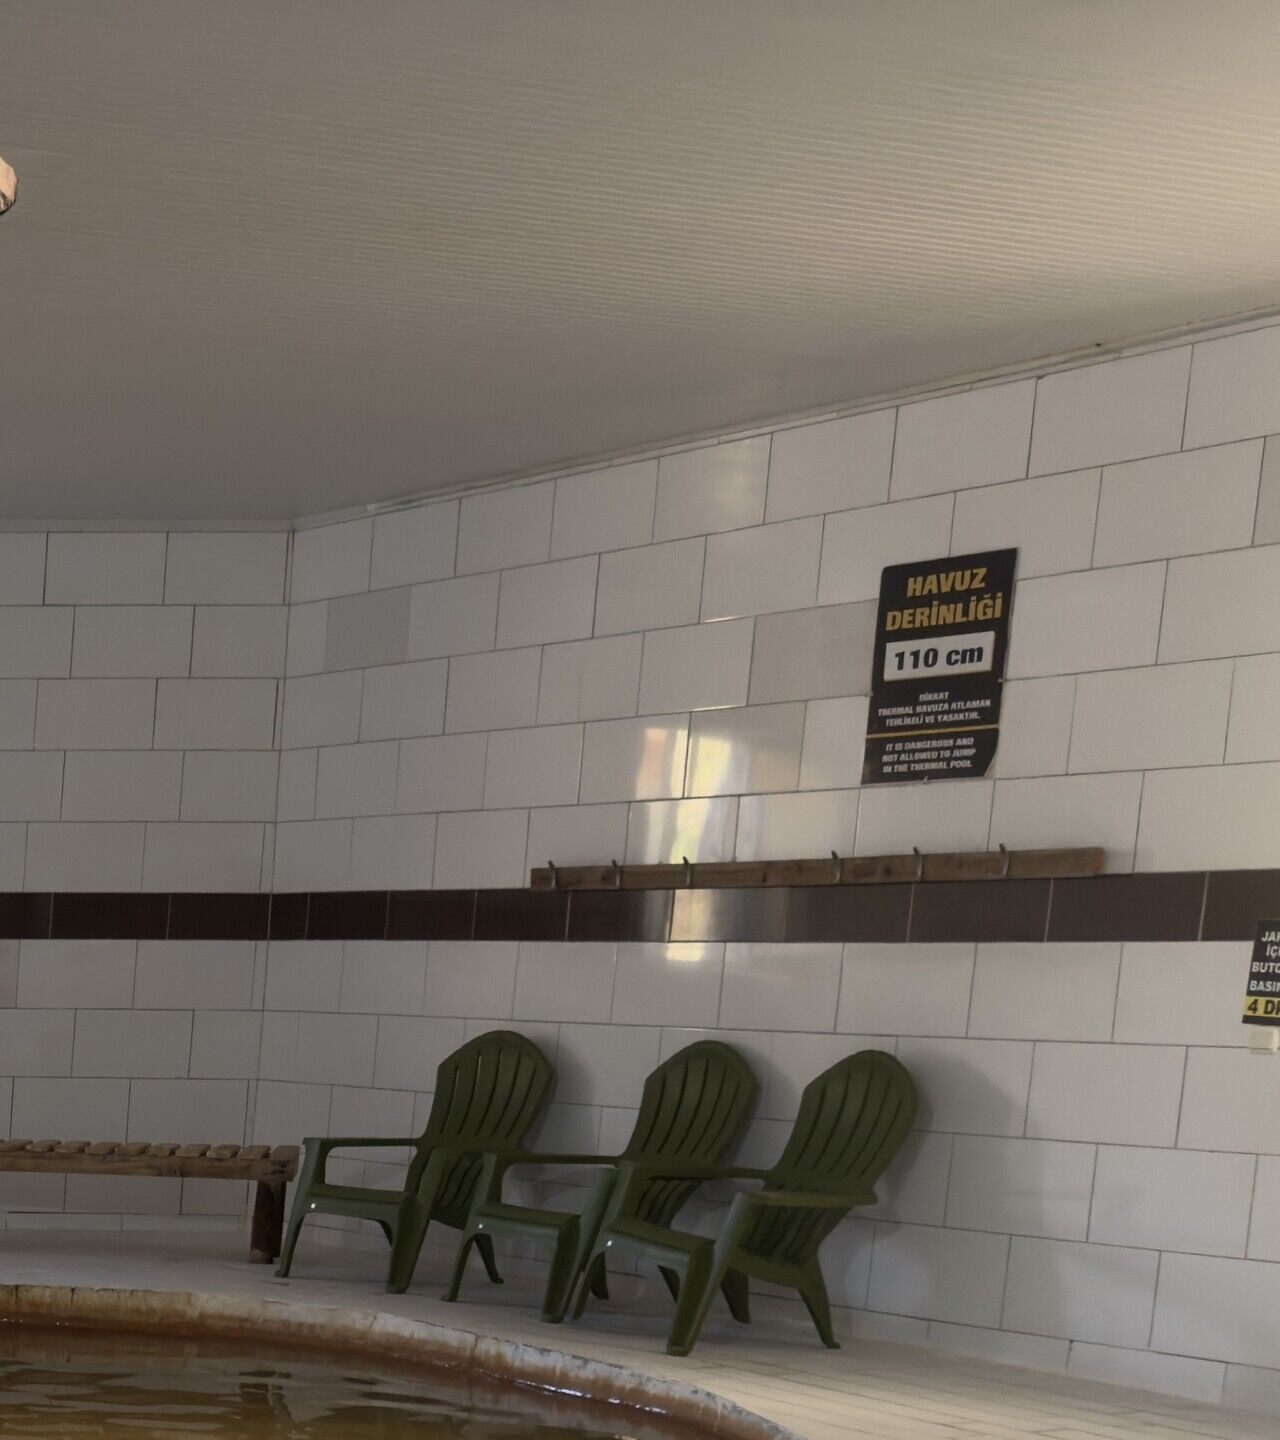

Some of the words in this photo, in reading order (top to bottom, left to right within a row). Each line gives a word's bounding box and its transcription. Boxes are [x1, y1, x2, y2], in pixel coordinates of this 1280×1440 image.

[906, 567, 988, 598] HAVUZ
[885, 592, 1004, 632] DERİNLİĞİ
[894, 647, 939, 671] 110
[946, 646, 984, 666] cm
[878, 705, 914, 716] THERMAL
[925, 713, 935, 723] VE
[882, 754, 898, 762] NOT
[899, 750, 938, 761] ALLOWED
[940, 749, 951, 758] TO
[883, 764, 892, 773] IN
[894, 763, 908, 773] THE
[910, 760, 948, 771] THERMAL
[949, 759, 972, 768] POOL
[1247, 998, 1259, 1014] 4
